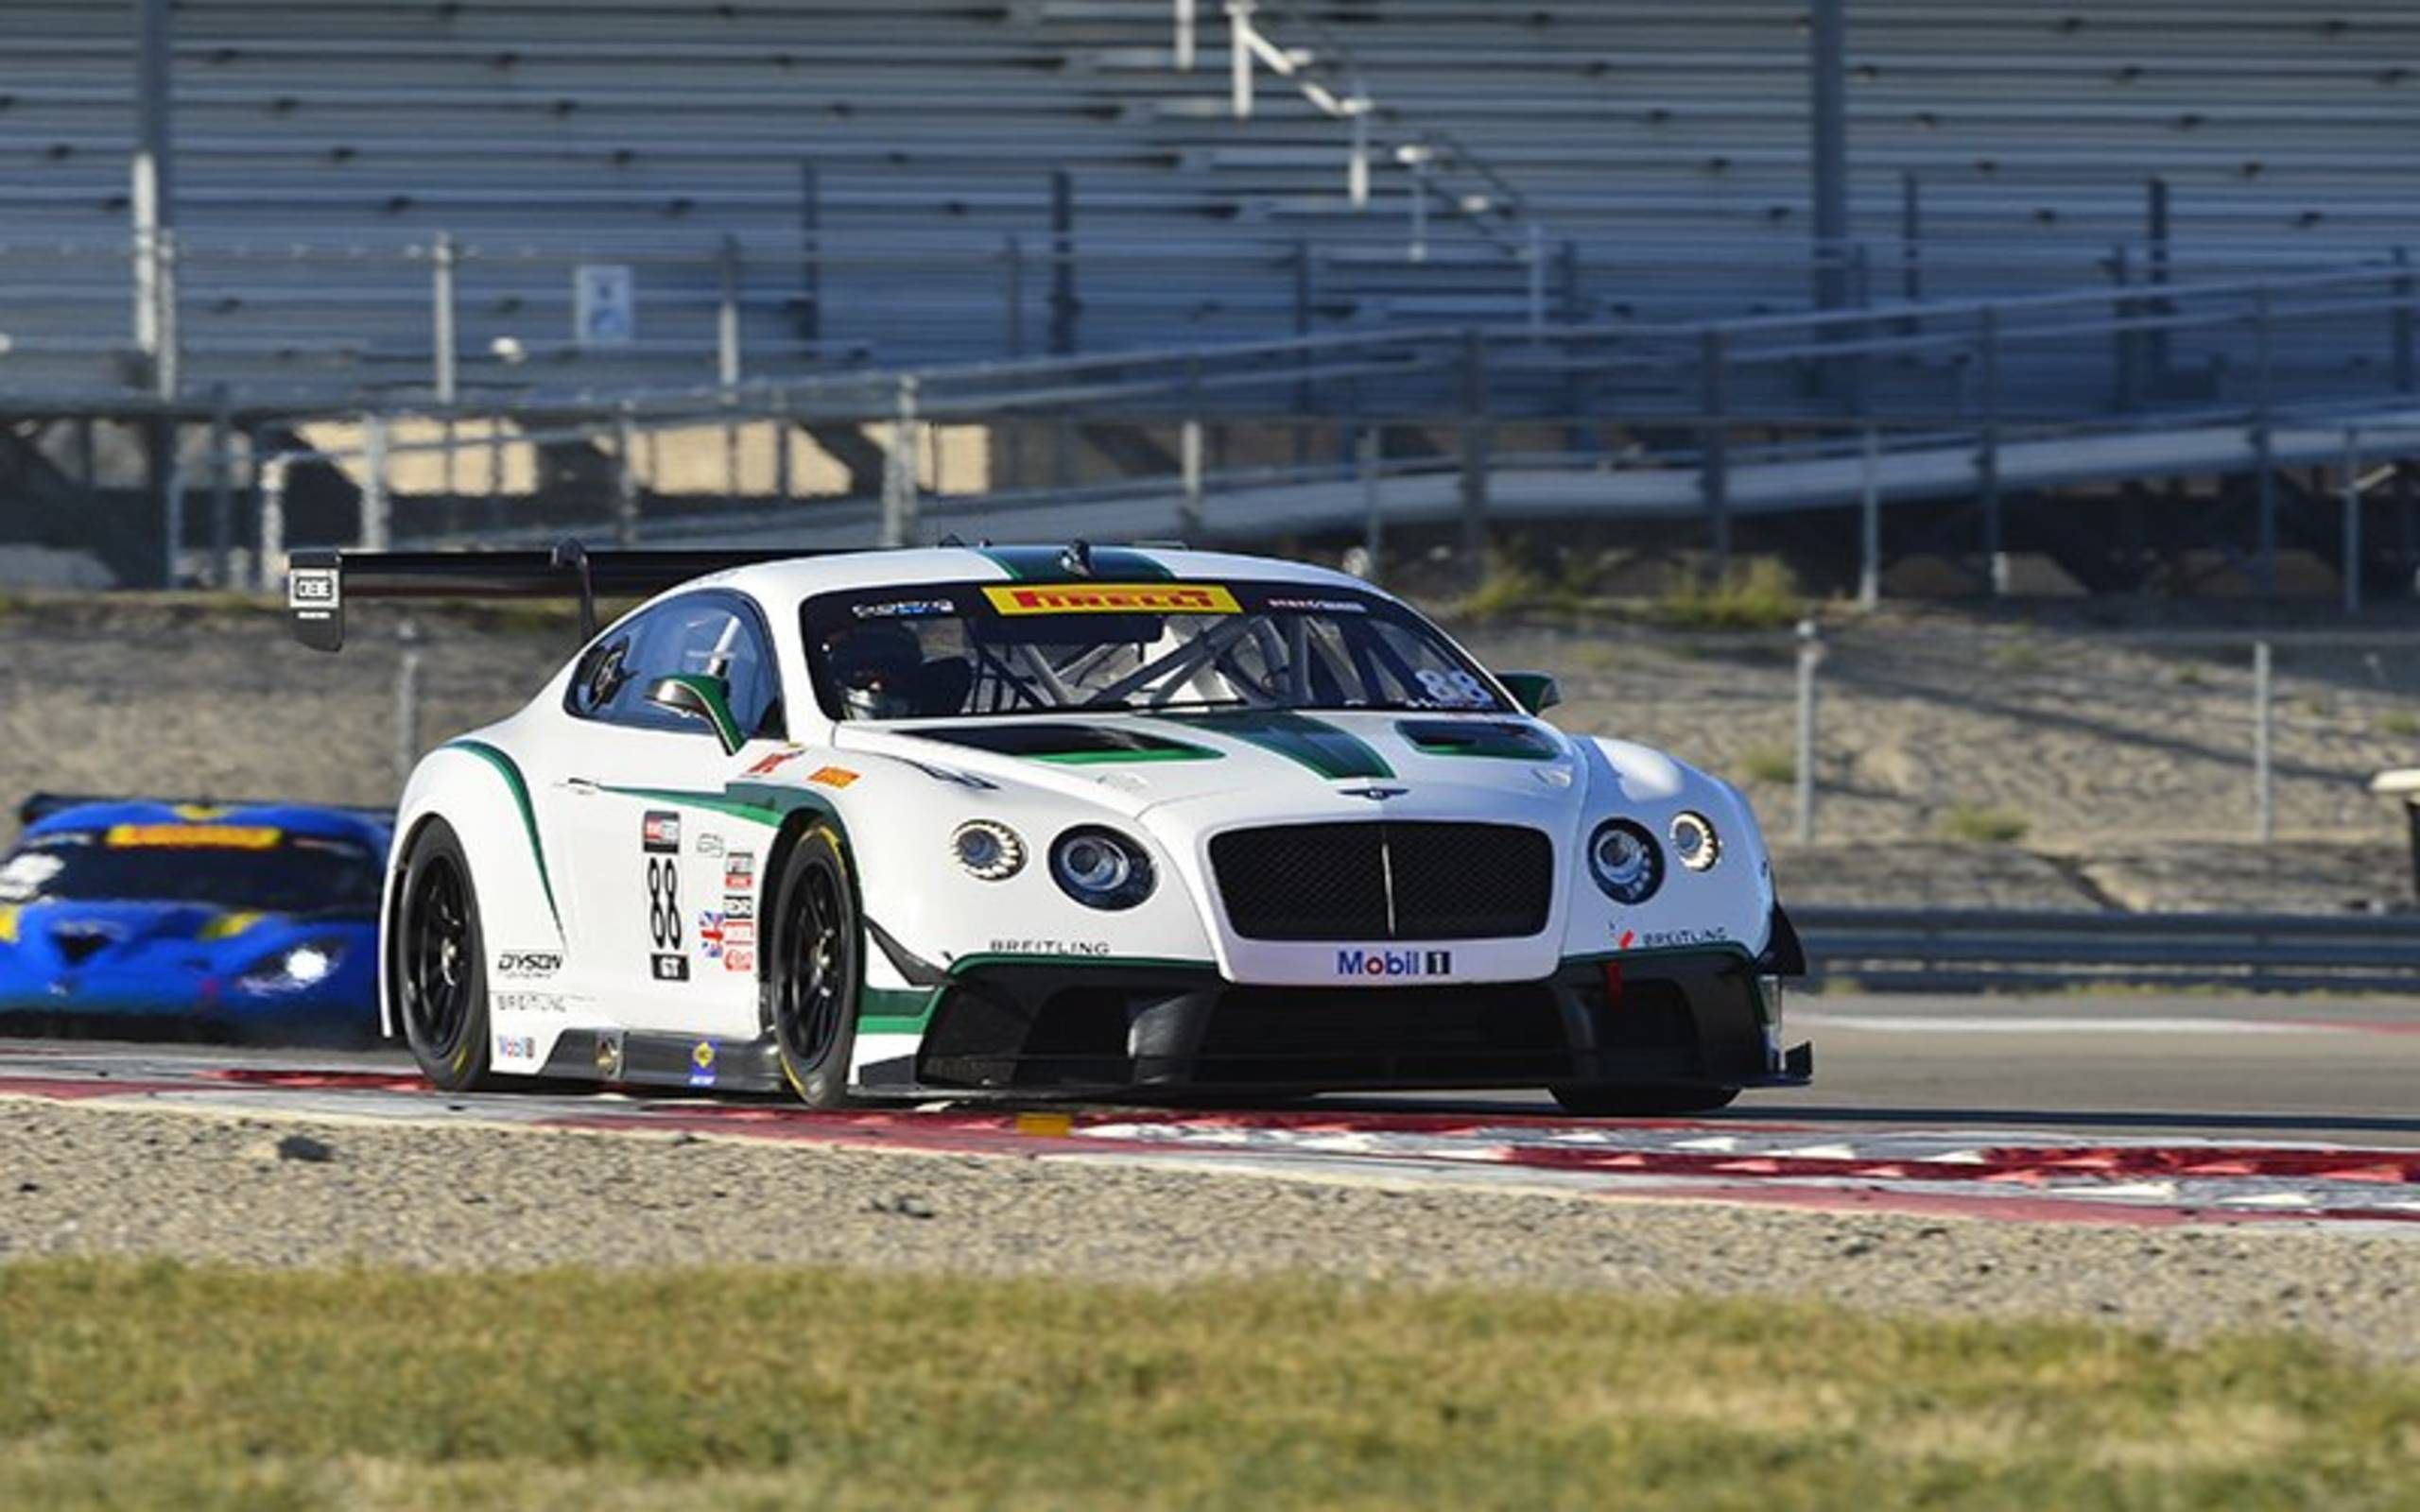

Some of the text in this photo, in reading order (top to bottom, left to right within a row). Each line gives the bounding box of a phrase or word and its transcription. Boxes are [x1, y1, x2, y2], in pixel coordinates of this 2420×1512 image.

[1011, 590, 1214, 609] PIRELLI
[648, 857, 682, 950] 88
[990, 939, 1111, 954] BREITLING
[497, 953, 563, 971] DYSON
[1338, 951, 1447, 975] Mobil 1
